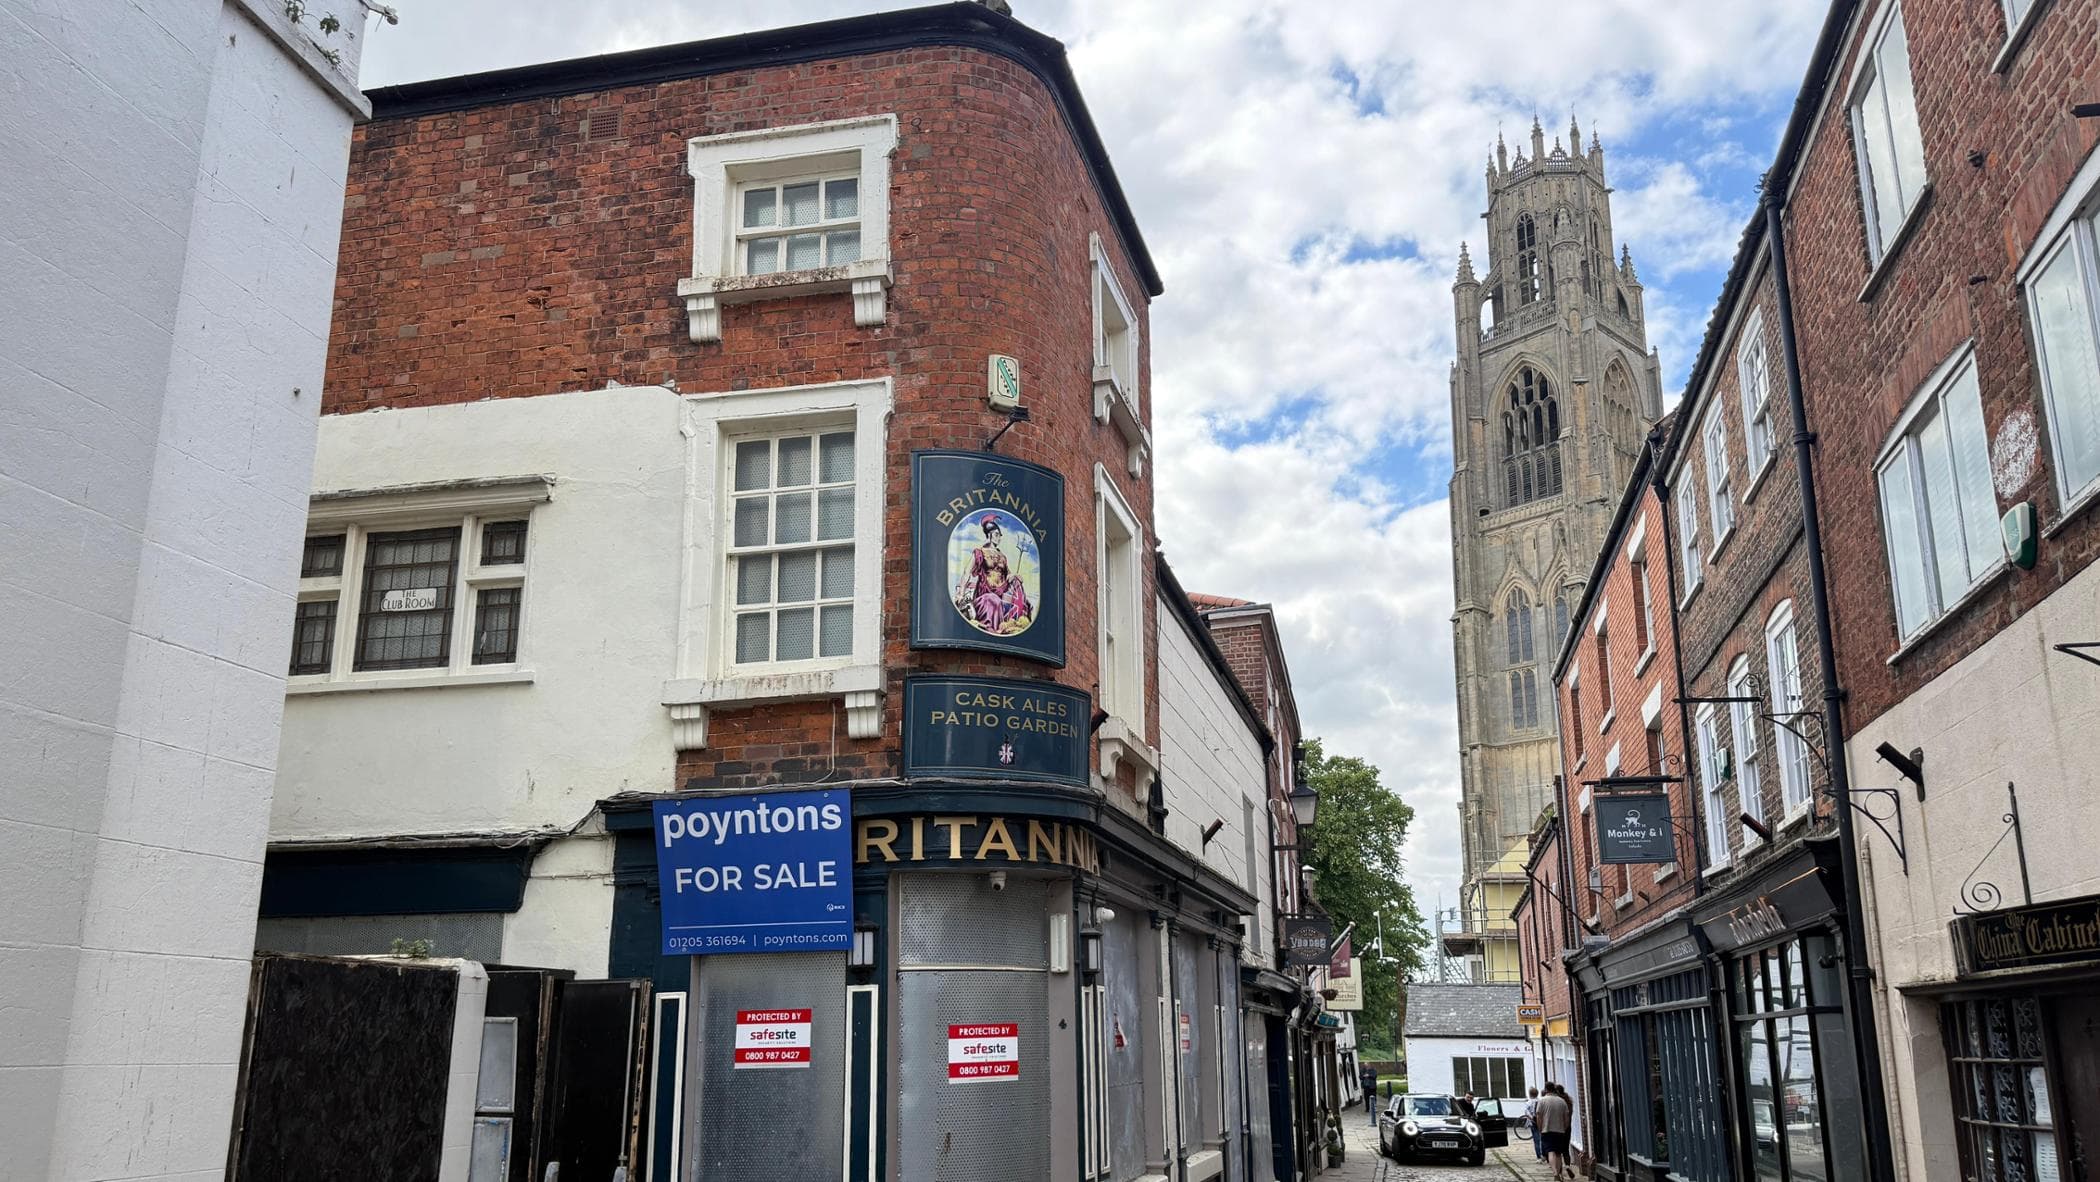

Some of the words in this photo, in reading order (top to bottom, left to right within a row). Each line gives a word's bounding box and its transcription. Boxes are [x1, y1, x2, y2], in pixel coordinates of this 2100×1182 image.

[982, 472, 1010, 488] The
[936, 488, 1047, 543] BRITANNIA
[403, 590, 417, 598] THE
[381, 598, 404, 610] CLUB
[405, 597, 436, 609] ROOM
[956, 692, 1016, 710] CASK
[1022, 698, 1068, 717] ALES
[930, 711, 1000, 728] PATIO
[1006, 716, 1079, 739] GARDEN
[662, 802, 842, 848] poyntons
[1607, 829, 1646, 839] Monkey
[1649, 828, 1657, 837] &
[855, 815, 1101, 877] RITANNIA
[675, 865, 743, 894] FOR
[753, 860, 838, 890] SALE
[669, 936, 703, 948] 01205
[706, 935, 746, 947] 361694
[764, 932, 848, 946] poyntons.com
[1976, 924, 2022, 962] China
[747, 1013, 790, 1022] PROTECTED
[792, 1012, 802, 1020] BY
[750, 1028, 797, 1041] safesite
[959, 1027, 1000, 1036] PROTECTED
[1001, 1027, 1010, 1035] BY
[745, 1052, 764, 1060] 0800
[766, 1051, 780, 1060] 987
[781, 1051, 800, 1059] 0427
[963, 1042, 1007, 1055] safesite
[959, 1066, 978, 1075] 0800
[980, 1066, 993, 1074] 987
[994, 1065, 1011, 1073] 0427
